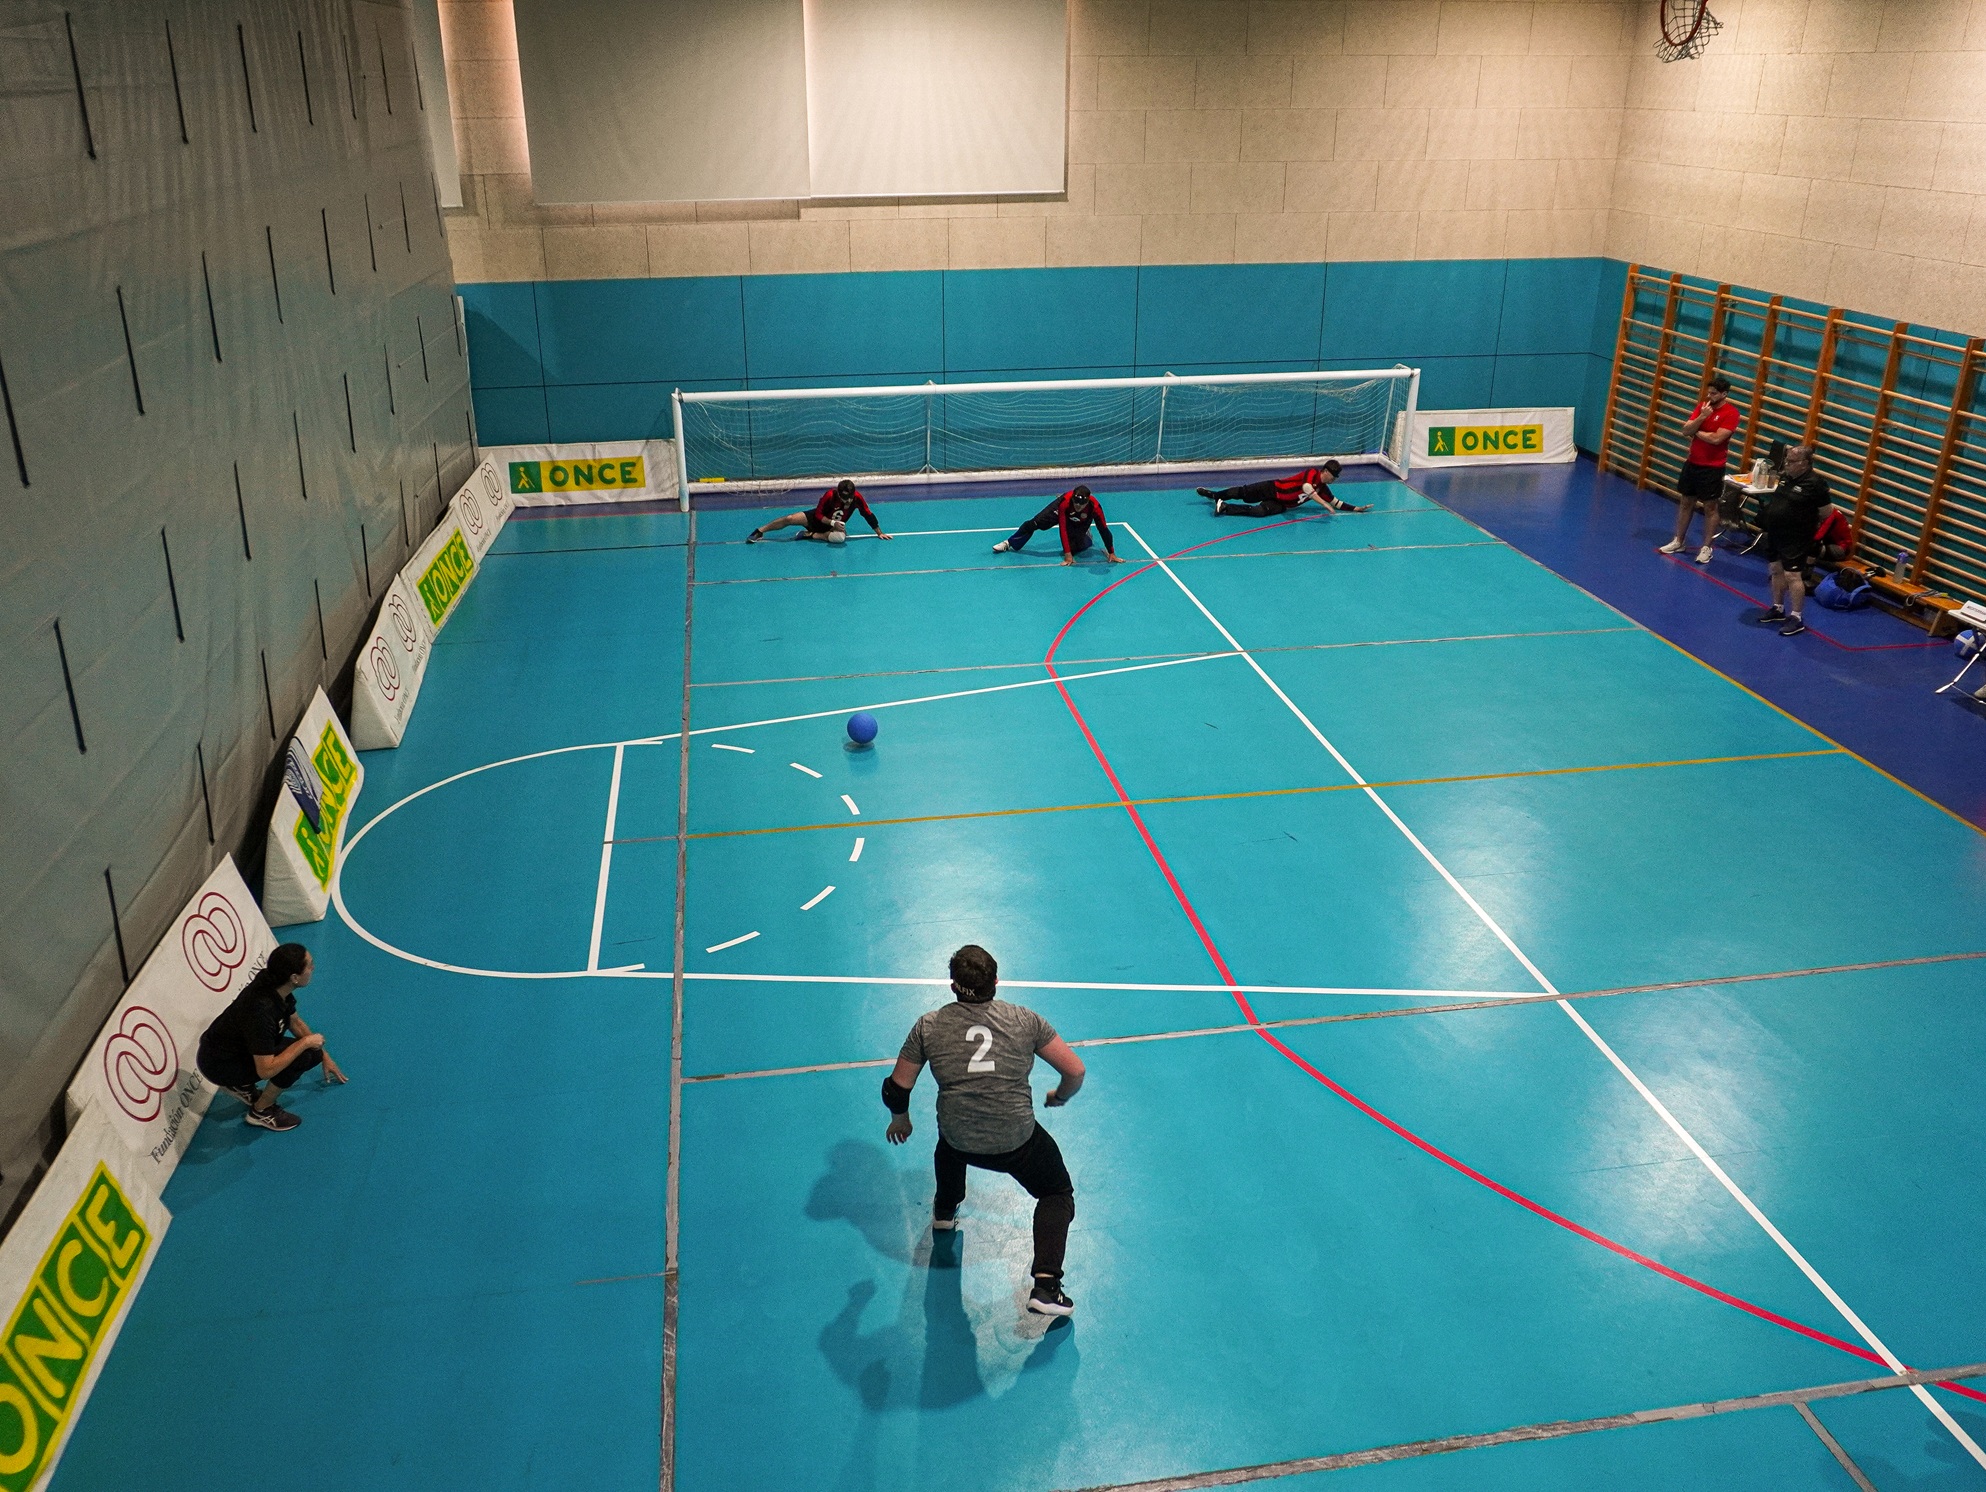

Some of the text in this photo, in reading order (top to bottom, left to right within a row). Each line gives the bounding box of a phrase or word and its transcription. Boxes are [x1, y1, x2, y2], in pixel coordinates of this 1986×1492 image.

[1462, 429, 1537, 451] ONCE
[549, 462, 638, 487] ONCE
[832, 509, 844, 521] 6
[432, 535, 472, 603] ONCE
[965, 1025, 996, 1073] 2
[150, 1068, 203, 1165] Fundación ONCE
